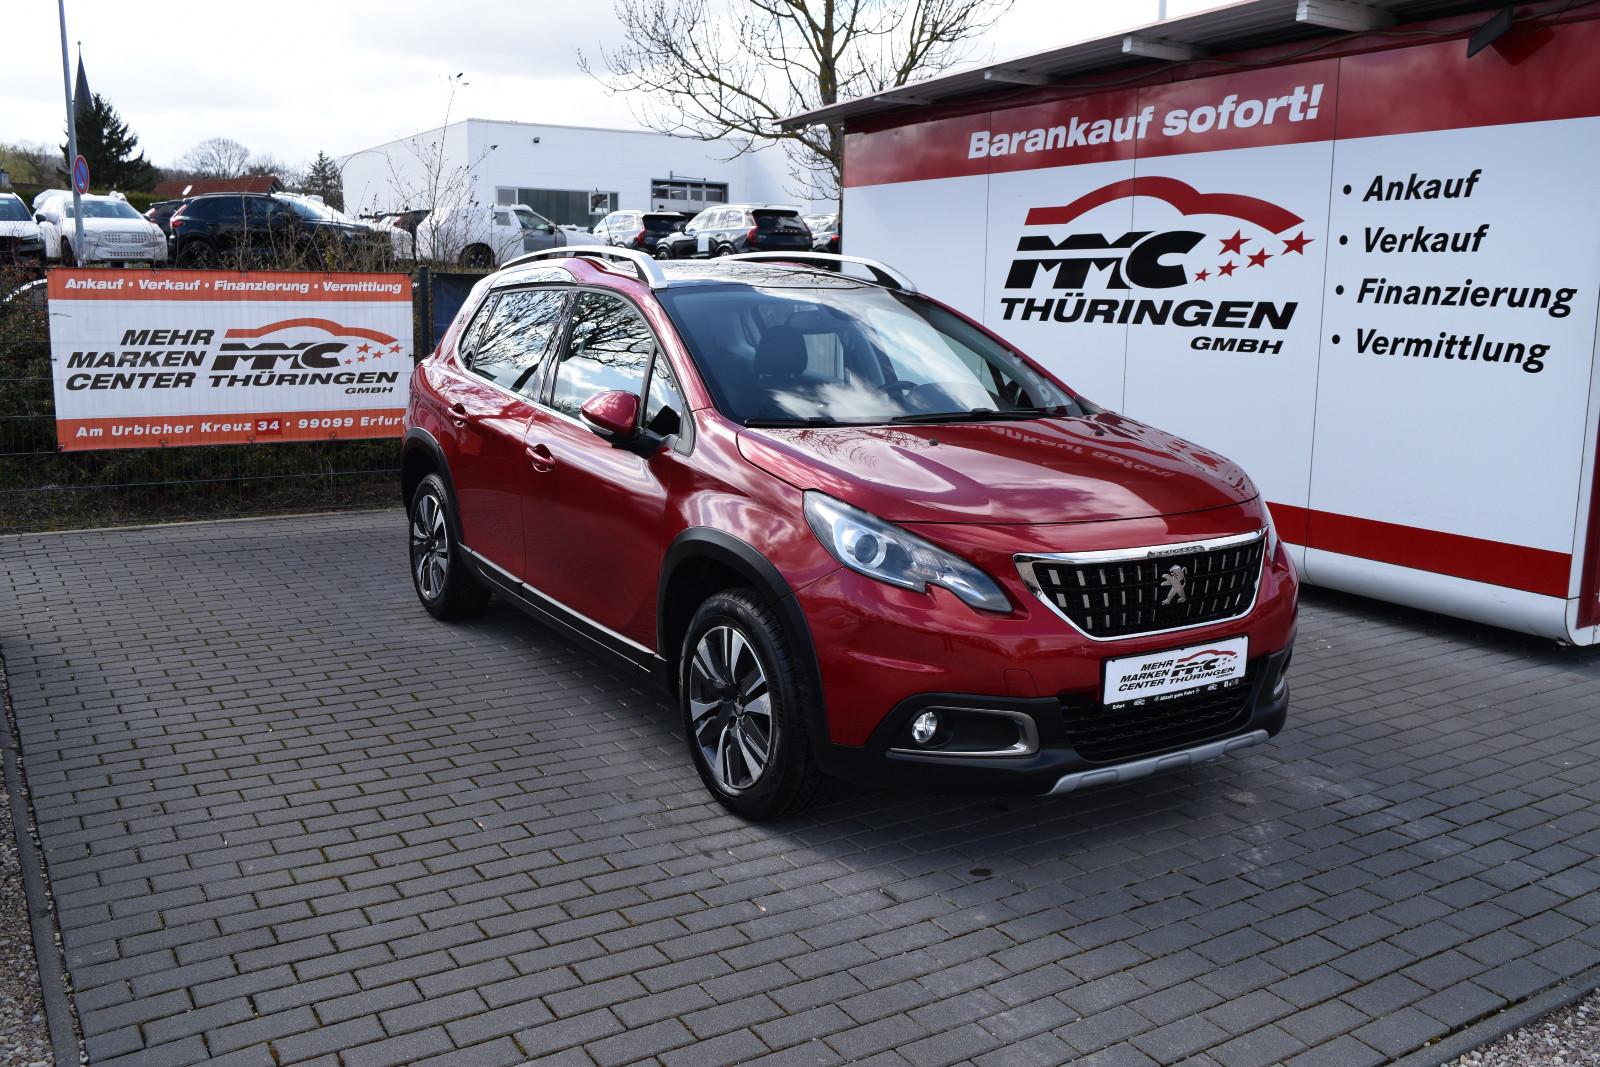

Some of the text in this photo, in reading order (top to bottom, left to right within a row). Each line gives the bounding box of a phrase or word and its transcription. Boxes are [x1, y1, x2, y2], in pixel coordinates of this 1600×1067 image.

[967, 83, 1324, 159] Barankauf sofort!
[1362, 169, 1482, 202] Ankauf
[1363, 224, 1490, 253] Verkauf
[1004, 230, 1207, 290] MMC
[65, 278, 124, 290] Ankauf
[138, 279, 201, 291] Verkauf
[213, 280, 309, 294] Finanzierung
[323, 281, 402, 294] Vermittlung
[1356, 277, 1578, 318] Finanzierung
[1000, 292, 1298, 330] THÜRINGEN
[120, 329, 215, 346] MEHR
[1190, 336, 1283, 354] GMBH
[66, 350, 207, 369] MARKEN
[210, 342, 349, 371] MMC
[1356, 328, 1551, 373] Vermittlung
[65, 372, 197, 391] CENTER
[208, 370, 399, 388] THÜRINGEN
[344, 386, 393, 395] GMBH
[76, 426, 103, 437] Am
[111, 423, 193, 437] Urbicher
[200, 422, 252, 433] Kreuz
[257, 420, 280, 431] 34
[298, 417, 353, 429] 99099
[1141, 660, 1174, 671] MEHR
[1120, 669, 1170, 682] MARKEN
[1119, 680, 1165, 691] CENTER
